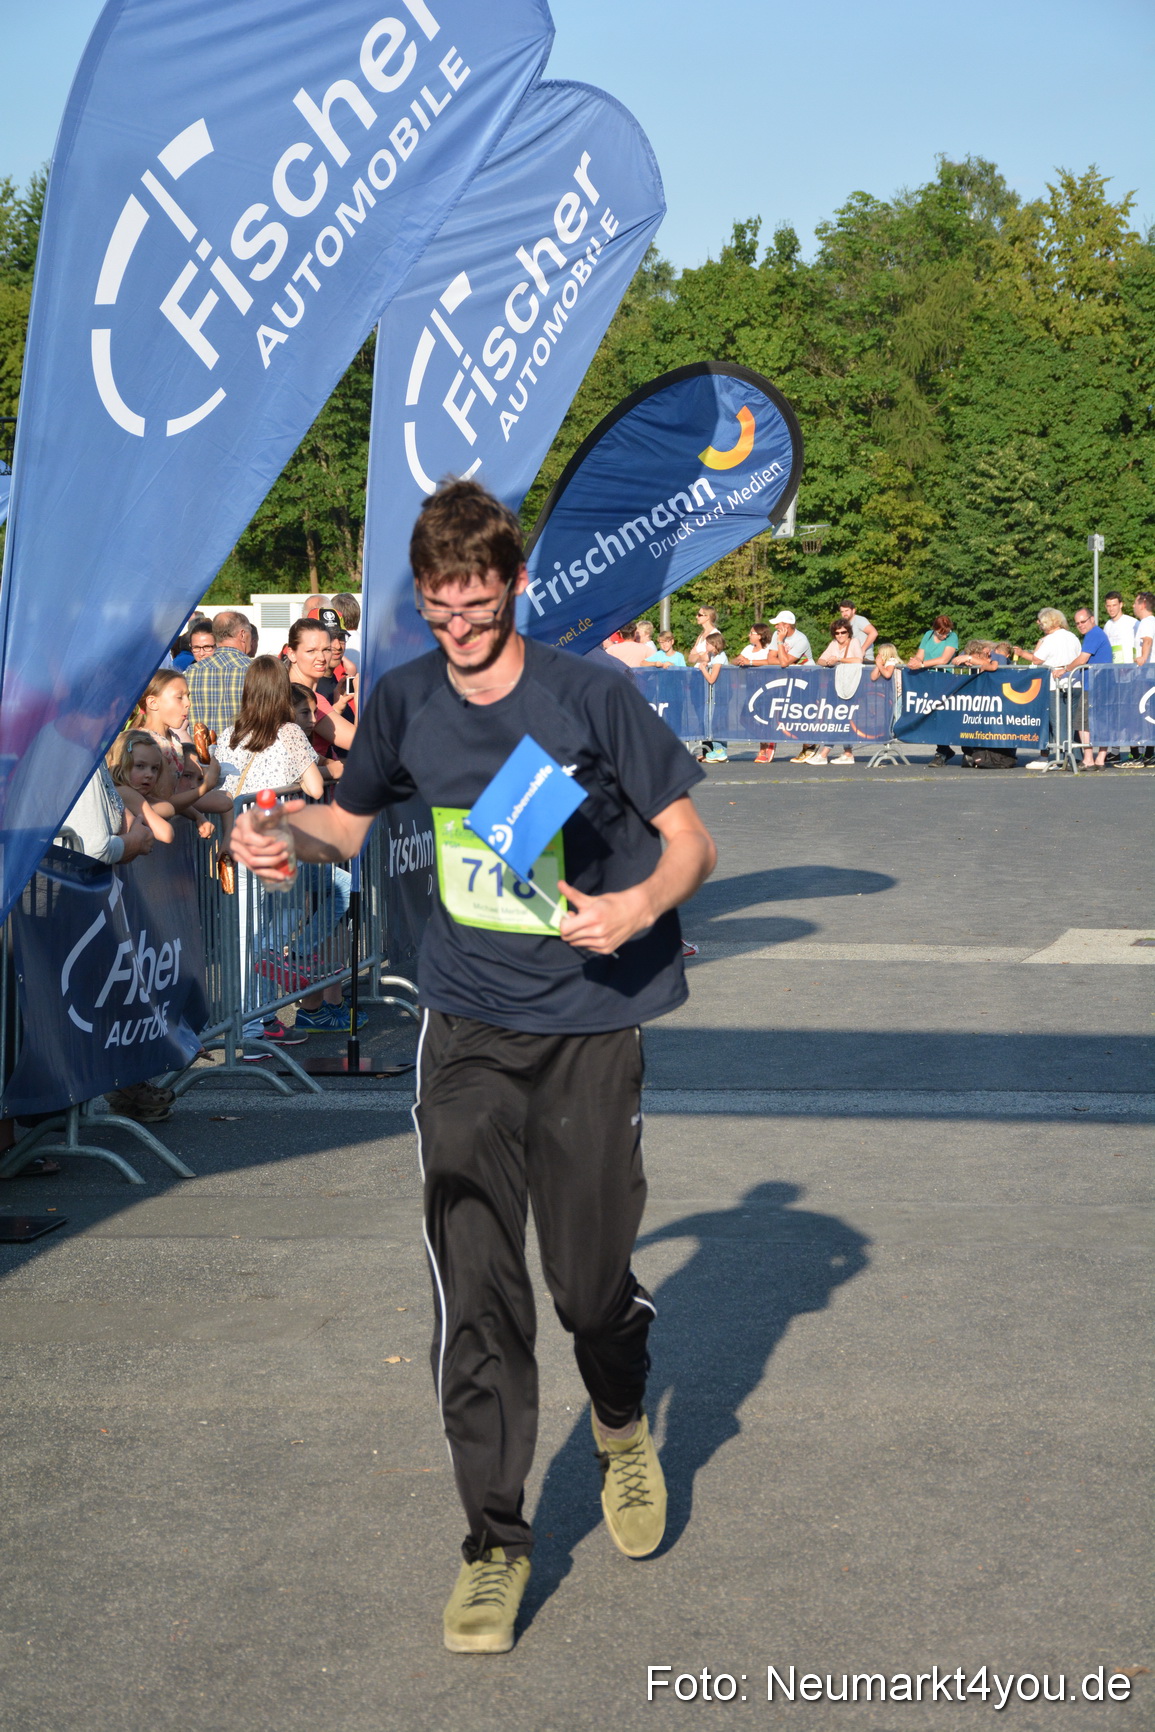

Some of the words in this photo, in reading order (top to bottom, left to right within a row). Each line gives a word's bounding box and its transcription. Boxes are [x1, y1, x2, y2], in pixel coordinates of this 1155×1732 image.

[255, 46, 472, 370] AUTOMOBILE
[442, 150, 601, 447] Fischer
[499, 207, 620, 443] AUTOMOBILE
[648, 521, 695, 559] Druck
[728, 461, 784, 510] Medien
[525, 476, 716, 617] Frischmann
[769, 698, 859, 720] Fischer
[905, 691, 1003, 715] Frischmann
[962, 713, 982, 725] Druck
[983, 714, 1004, 726] und
[1005, 714, 1041, 727] Medien
[776, 722, 851, 733] AUTOMOBILE
[959, 730, 1040, 742] www.frischmann-net.de
[461, 857, 537, 900] 718
